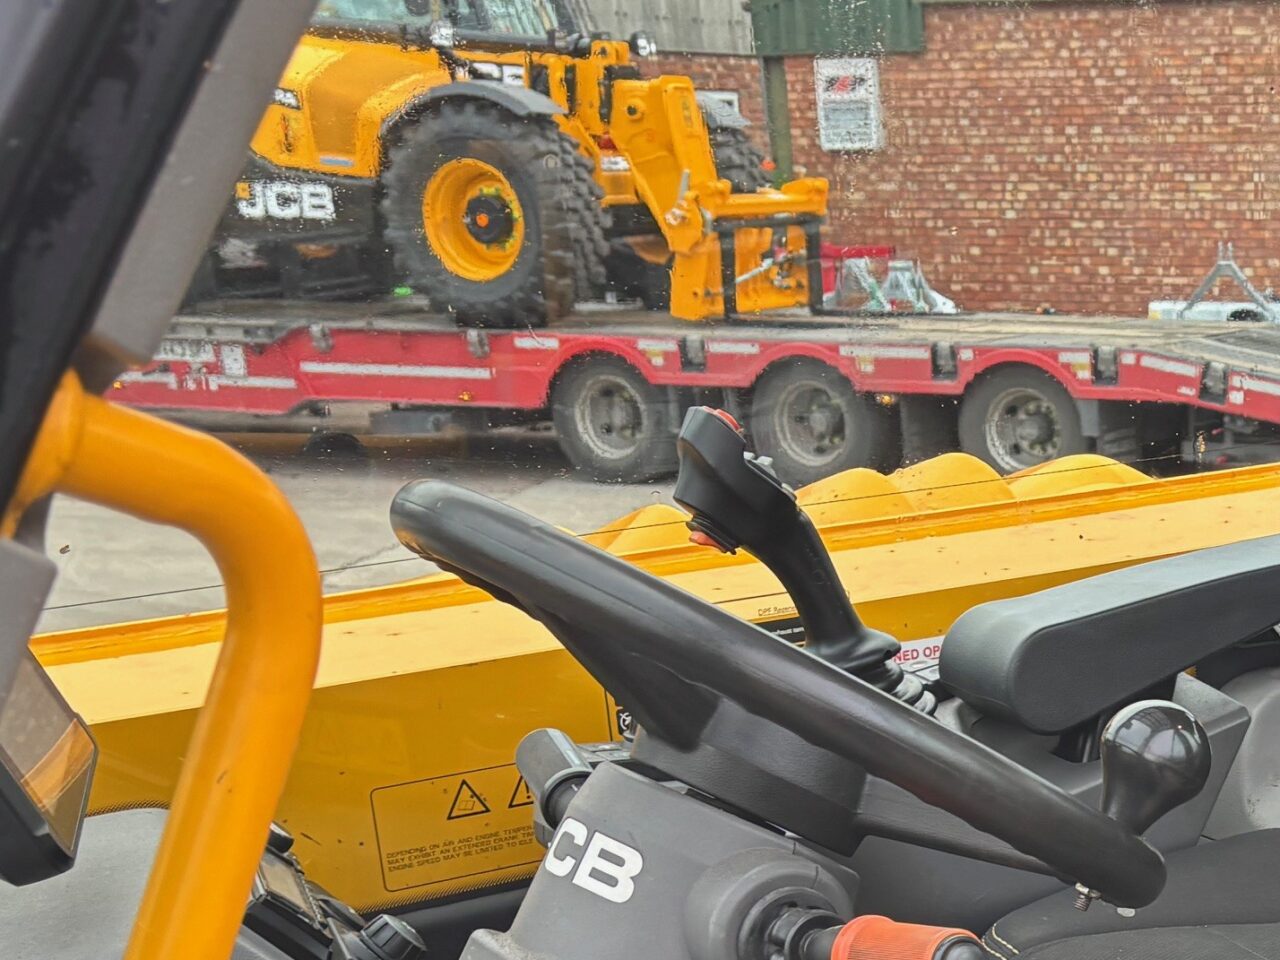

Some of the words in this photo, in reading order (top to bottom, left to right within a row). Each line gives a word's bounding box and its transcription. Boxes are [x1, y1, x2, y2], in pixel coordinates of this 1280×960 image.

[234, 181, 336, 219] JCB
[923, 645, 941, 658] OP
[545, 818, 643, 903] CB
